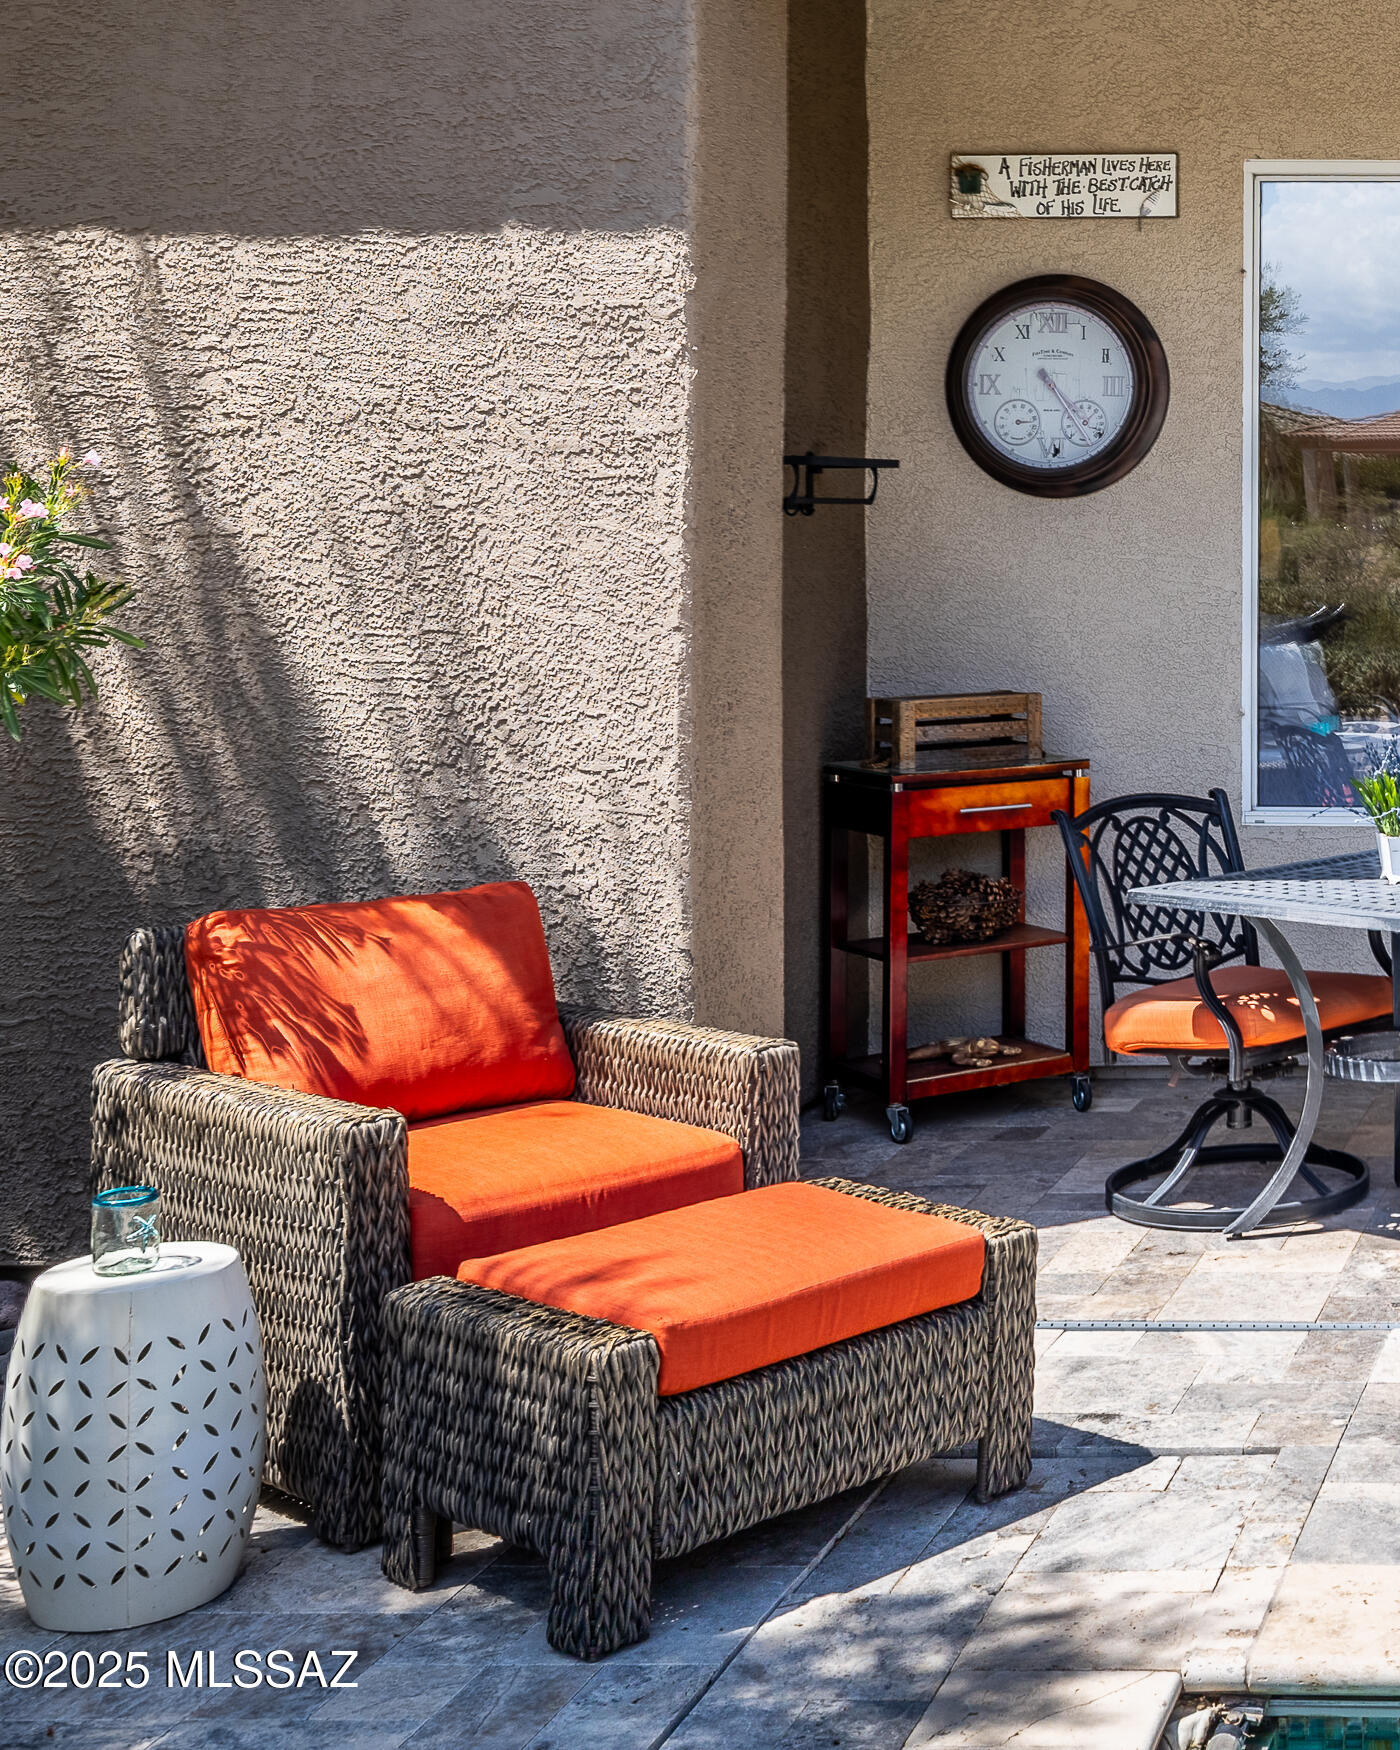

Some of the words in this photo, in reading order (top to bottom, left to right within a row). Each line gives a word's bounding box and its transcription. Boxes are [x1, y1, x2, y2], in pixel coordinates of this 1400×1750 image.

[998, 157, 1011, 180] A
[1019, 157, 1097, 177] FISHERMAN
[1102, 158, 1136, 176] LIVES
[1139, 157, 1171, 174] HERE
[1009, 178, 1048, 198] WITH
[1053, 178, 1081, 196] THE
[1129, 175, 1173, 193] CATCH
[1036, 199, 1055, 215] OF
[1061, 199, 1084, 216] HIS
[1092, 194, 1121, 215] LIFE
[1015, 324, 1031, 339] XI
[1038, 312, 1069, 333] XII
[993, 346, 1005, 361] X
[979, 374, 1001, 395] IX
